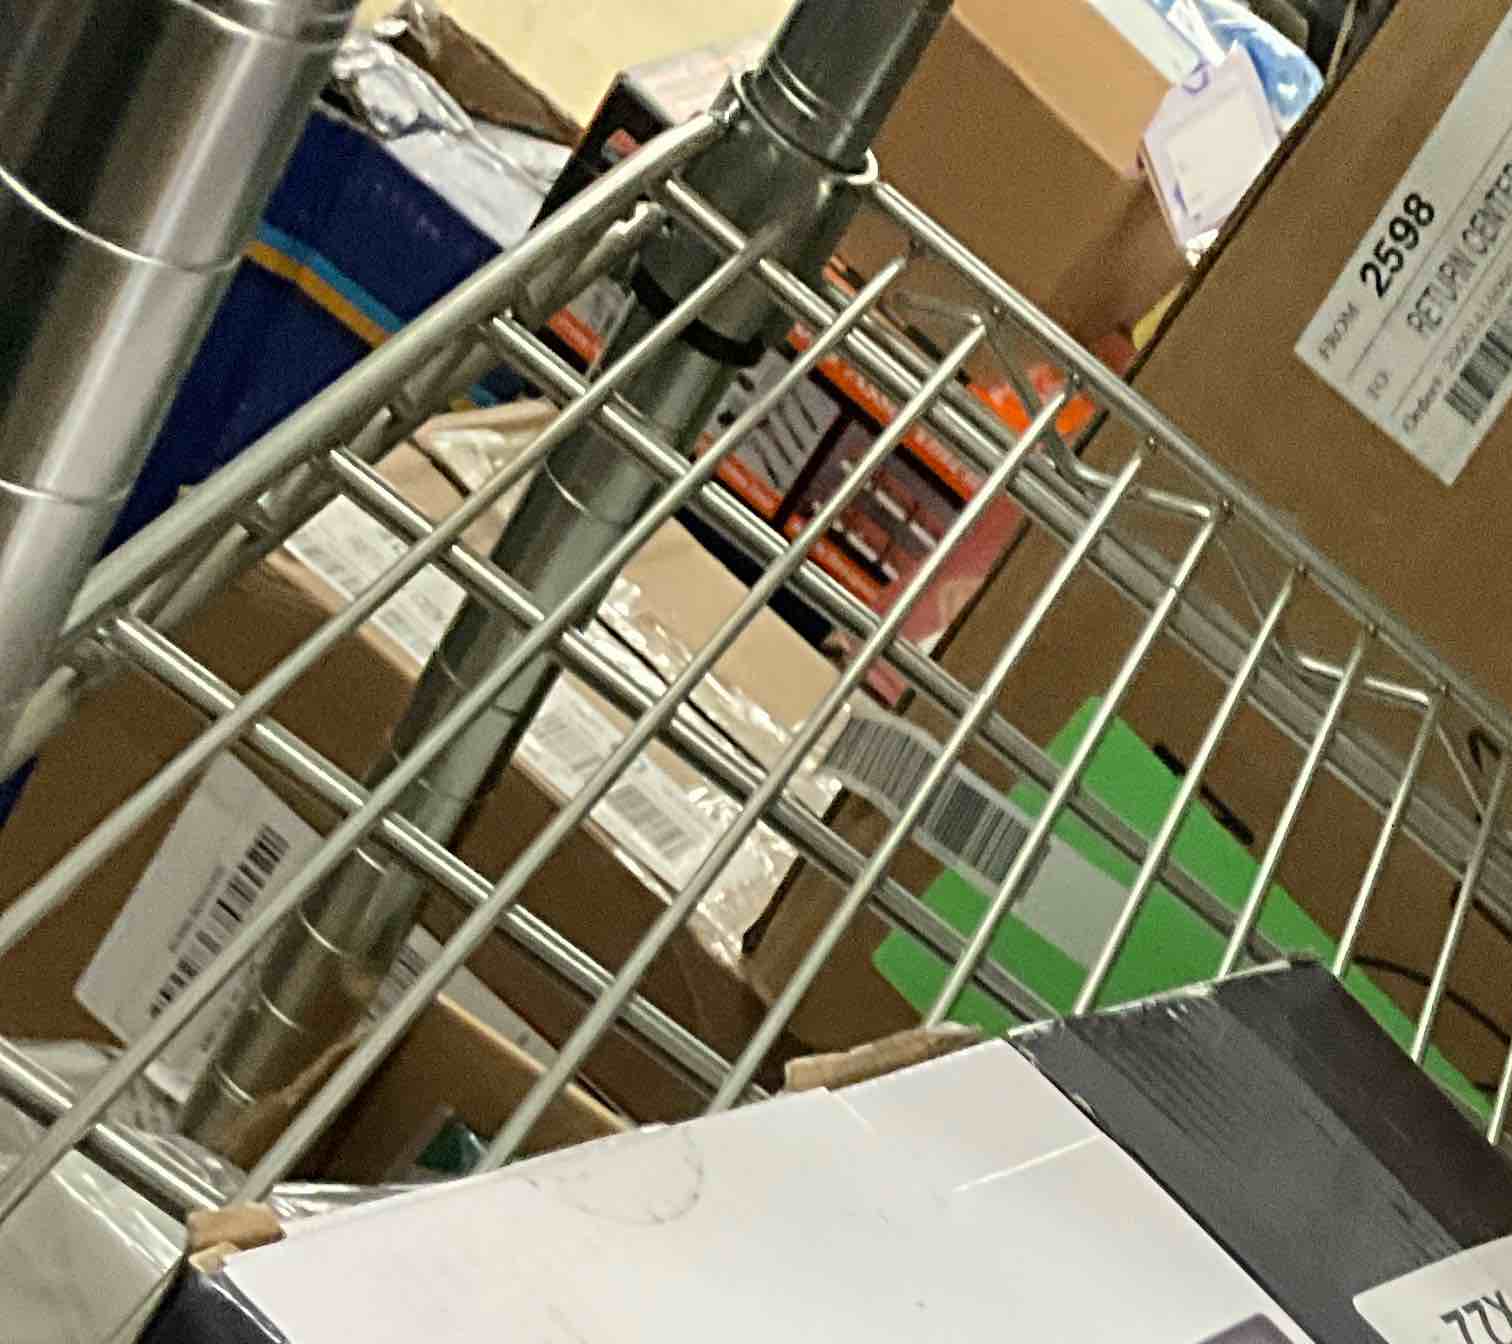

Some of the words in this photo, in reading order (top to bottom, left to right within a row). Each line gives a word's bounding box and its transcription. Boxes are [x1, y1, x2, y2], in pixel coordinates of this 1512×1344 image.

[1318, 301, 1360, 362] FROM
[1360, 193, 1435, 298] 2598
[1407, 252, 1477, 334] RETURN
